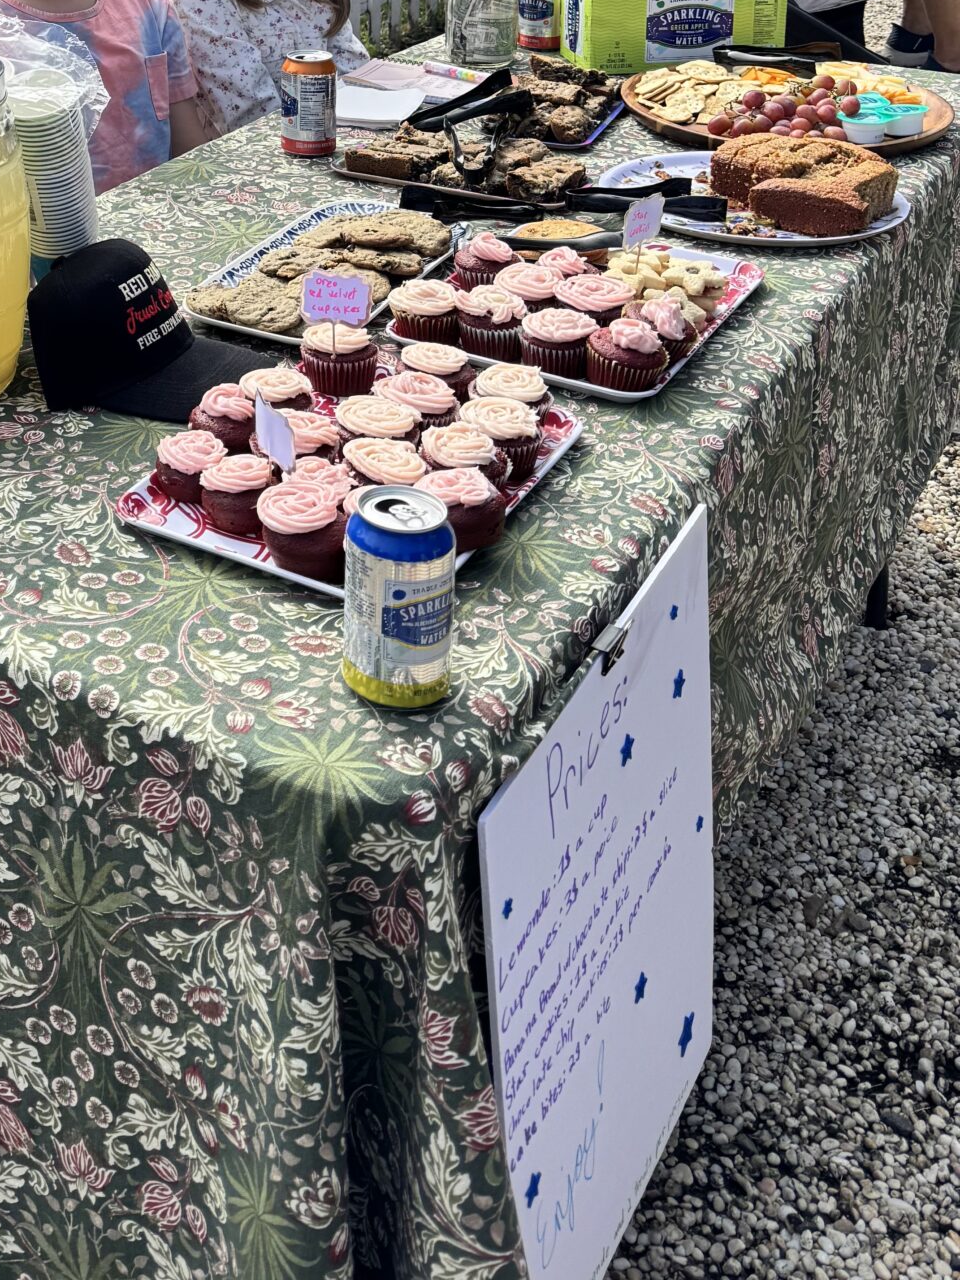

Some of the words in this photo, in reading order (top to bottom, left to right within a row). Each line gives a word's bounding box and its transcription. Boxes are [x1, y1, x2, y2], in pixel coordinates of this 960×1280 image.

[659, 8, 721, 26] SPARKLING
[690, 22, 709, 30] APPLE
[675, 36, 703, 45] WATER
[118, 273, 149, 302] RED
[126, 294, 161, 335] Truck
[136, 328, 161, 350] FIRE
[421, 626, 448, 645] WATER
[546, 675, 628, 839] Prices:
[576, 836, 583, 852] a
[588, 793, 608, 833] cup
[582, 871, 590, 888] a
[504, 1013, 537, 1075] Banana
[650, 809, 656, 821] a
[659, 766, 677, 806] slice
[555, 1018, 575, 1056] chip
[629, 894, 643, 934] per
[505, 1060, 529, 1110] Star
[591, 948, 597, 962] a
[600, 885, 630, 945] cookie
[511, 1121, 538, 1173] cake
[584, 1032, 591, 1046] a
[596, 995, 611, 1024] bite
